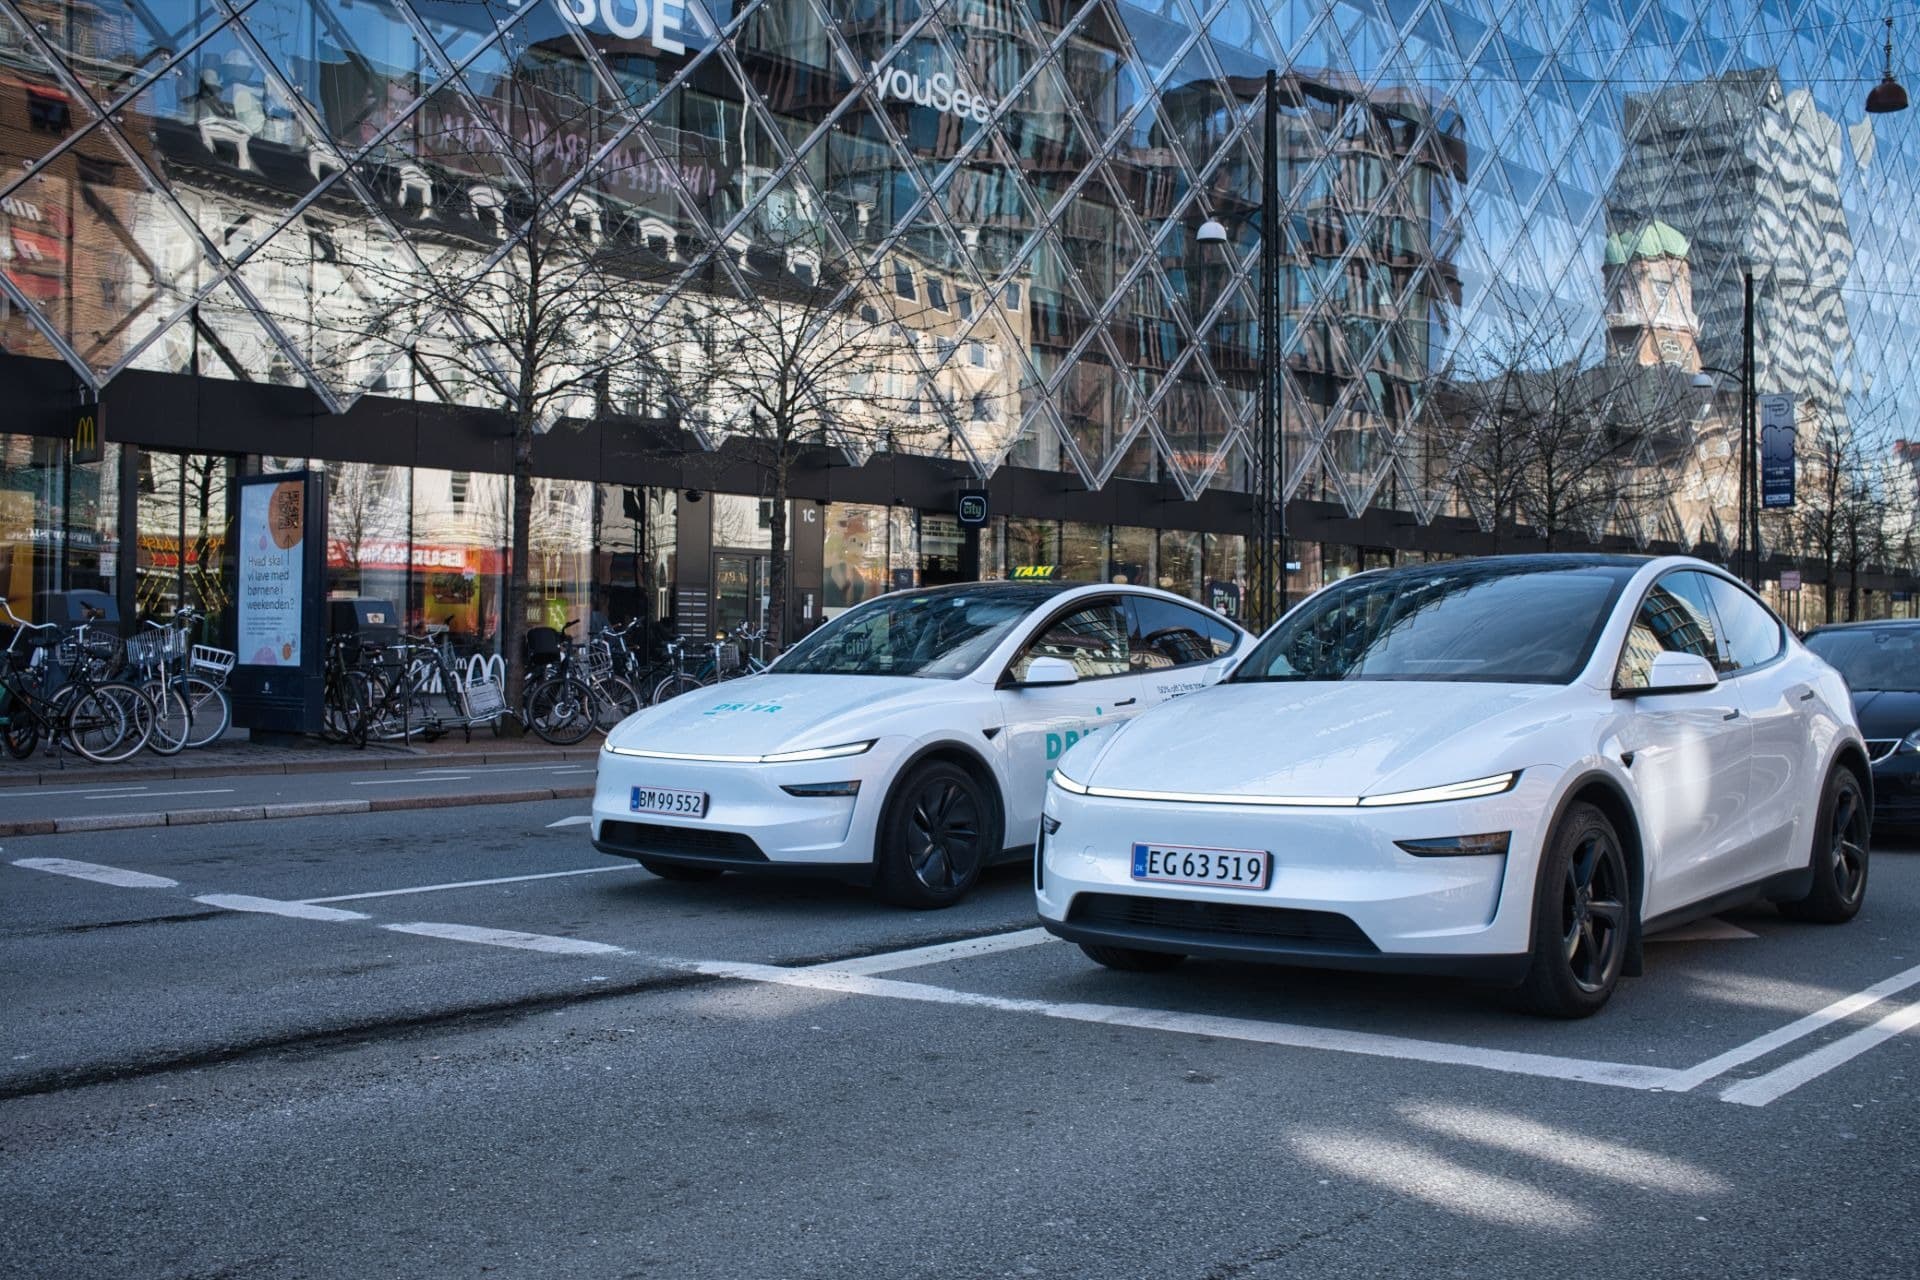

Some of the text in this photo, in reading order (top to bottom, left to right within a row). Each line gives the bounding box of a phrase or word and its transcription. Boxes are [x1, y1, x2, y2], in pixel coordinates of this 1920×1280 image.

[871, 61, 990, 124] youSee
[802, 508, 816, 523] 1C
[1014, 565, 1054, 577] TAXI
[640, 790, 701, 813] BM 99 552
[1148, 850, 1261, 882] EG 63 519
